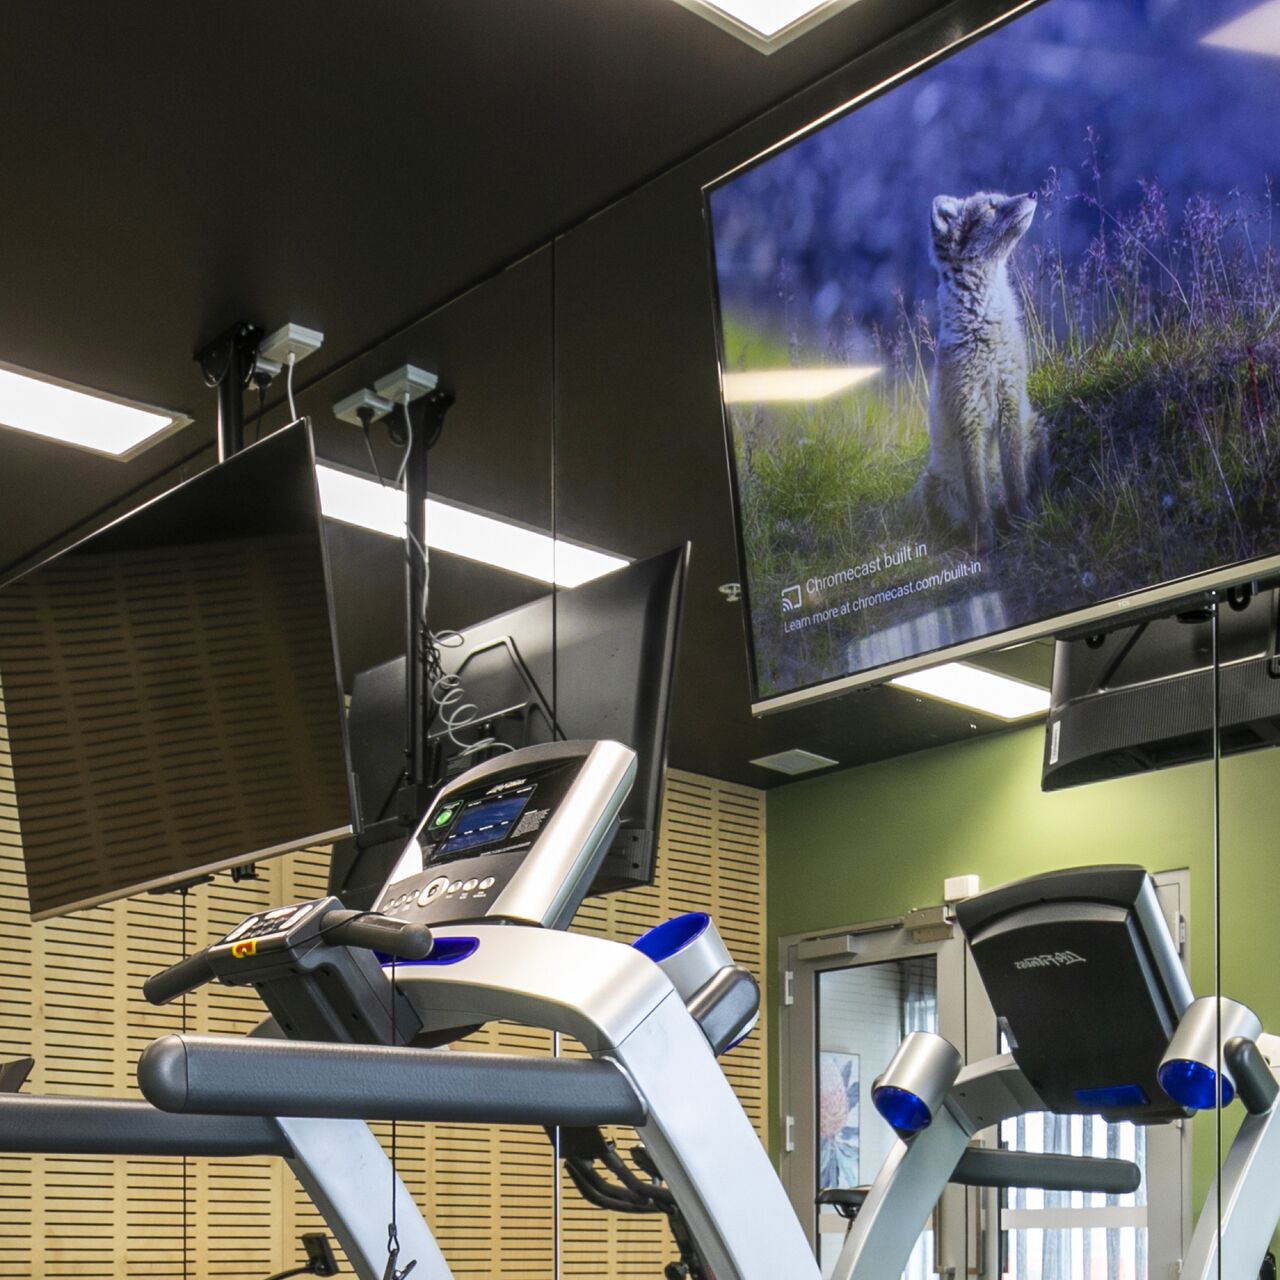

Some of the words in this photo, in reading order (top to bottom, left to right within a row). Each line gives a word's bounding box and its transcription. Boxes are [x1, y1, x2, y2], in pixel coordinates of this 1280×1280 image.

[784, 615, 811, 633] Learn
[813, 607, 838, 625] more
[840, 602, 851, 615] at
[852, 561, 982, 612] chromecast.com/built-in
[805, 557, 880, 595] Chromecast
[884, 547, 912, 569] built
[915, 543, 928, 558] in
